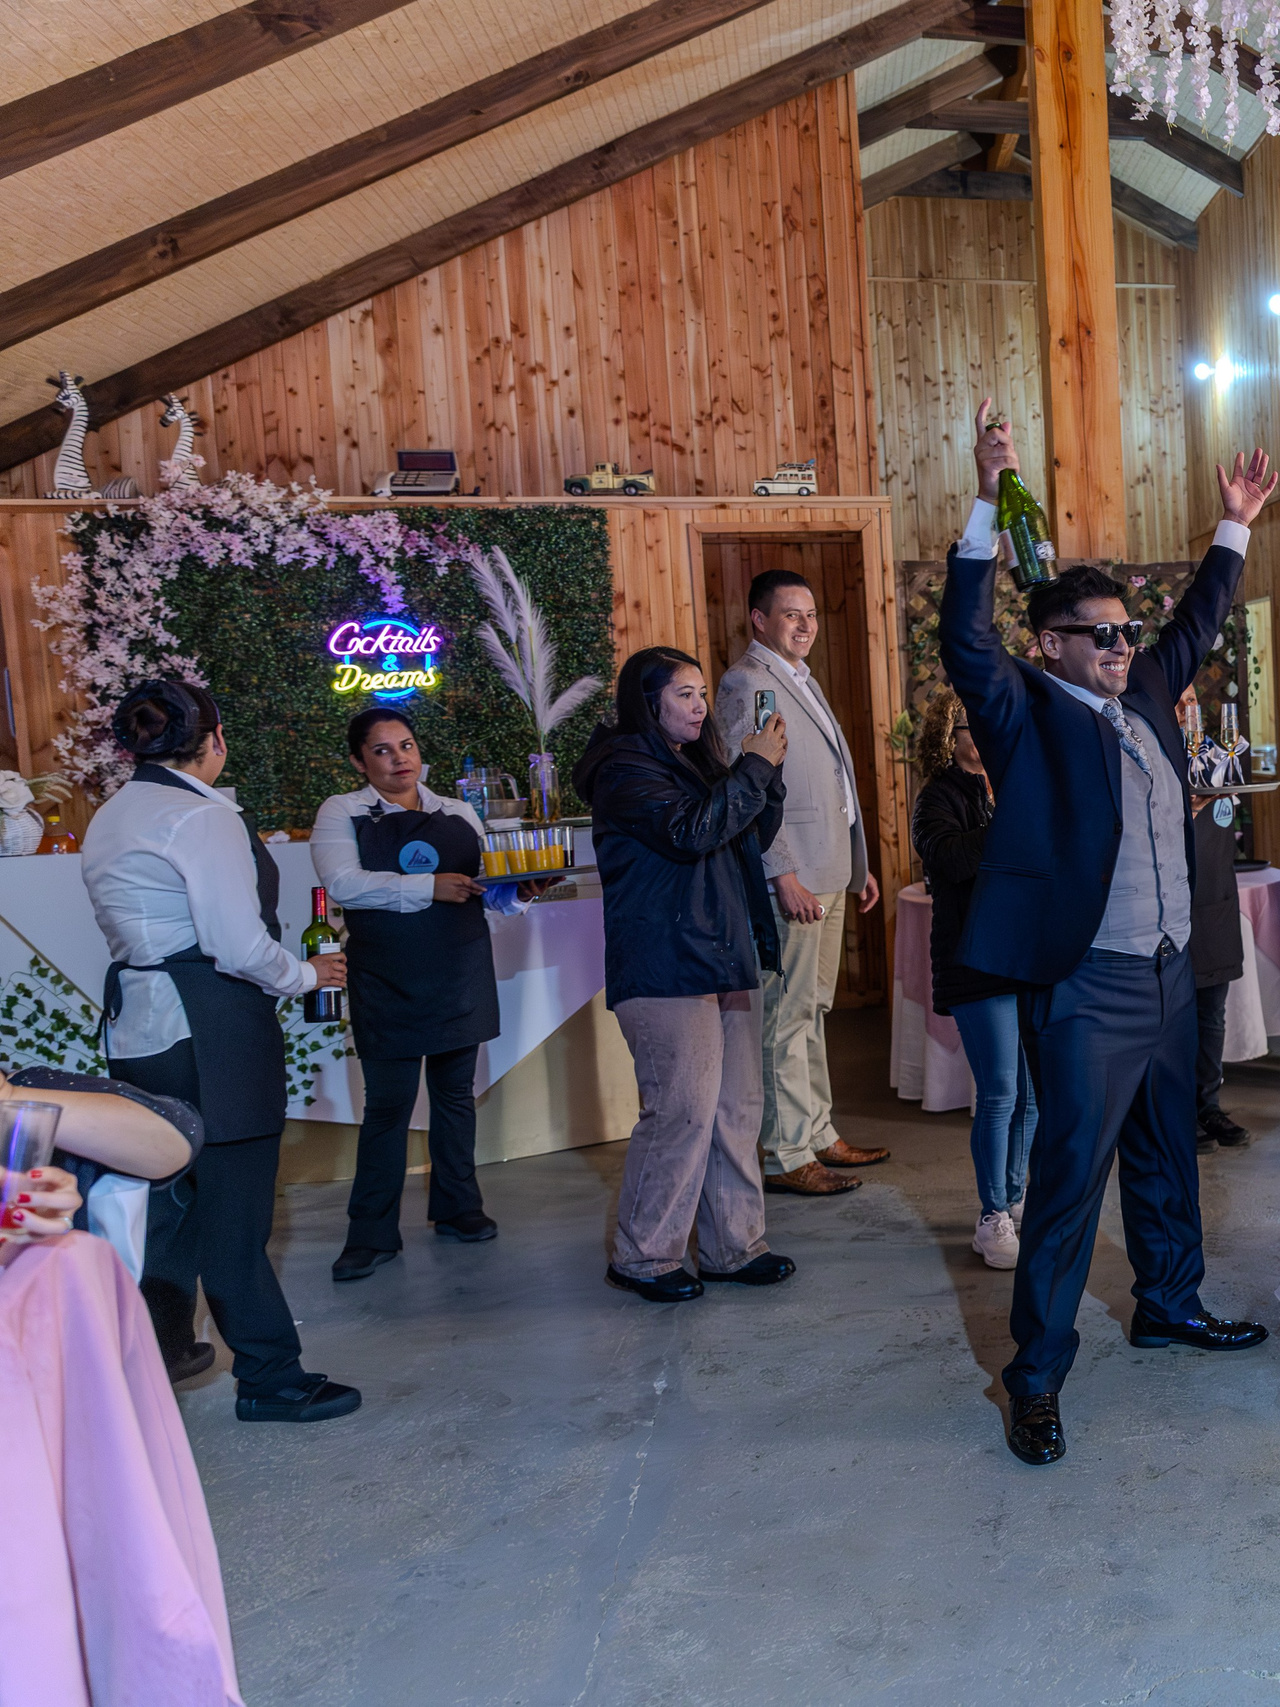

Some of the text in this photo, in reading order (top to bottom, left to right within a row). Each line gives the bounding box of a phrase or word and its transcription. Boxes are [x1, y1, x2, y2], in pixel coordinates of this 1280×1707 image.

[329, 621, 442, 655] Cocktails
[381, 654, 400, 671] &
[333, 664, 438, 692] Dreams
